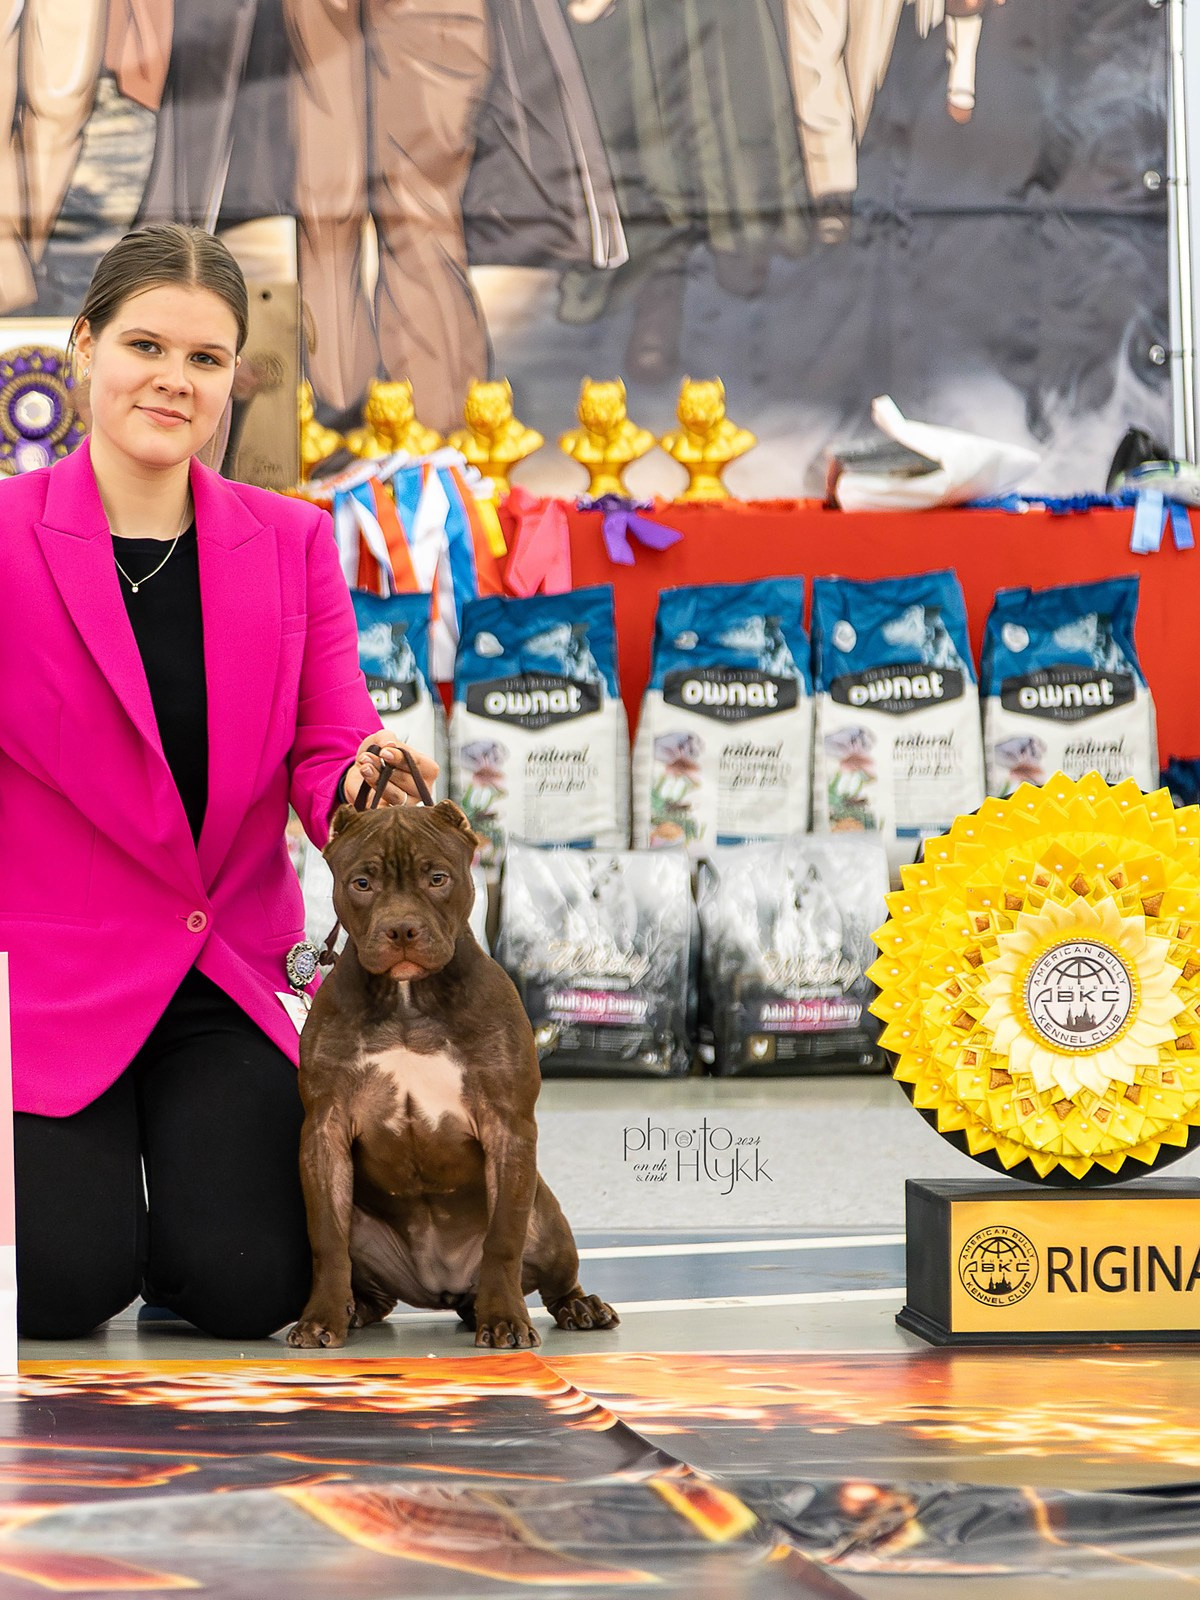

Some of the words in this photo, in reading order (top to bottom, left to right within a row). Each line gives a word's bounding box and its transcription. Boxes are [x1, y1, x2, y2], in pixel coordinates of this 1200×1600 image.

[484, 684, 581, 715] ownat
[682, 680, 778, 708] ownat
[848, 671, 944, 706] ownat
[1019, 678, 1114, 709] ownat
[1034, 947, 1092, 986] AMERICAN
[1098, 952, 1126, 984] BULLY
[1038, 1015, 1086, 1043] KENNEL
[1092, 1014, 1122, 1041] CLUB
[963, 1229, 1008, 1260] AMERICAN
[1012, 1232, 1035, 1258] BULLY
[966, 1281, 1004, 1304] KENNEL
[1008, 1281, 1032, 1302] CLUB
